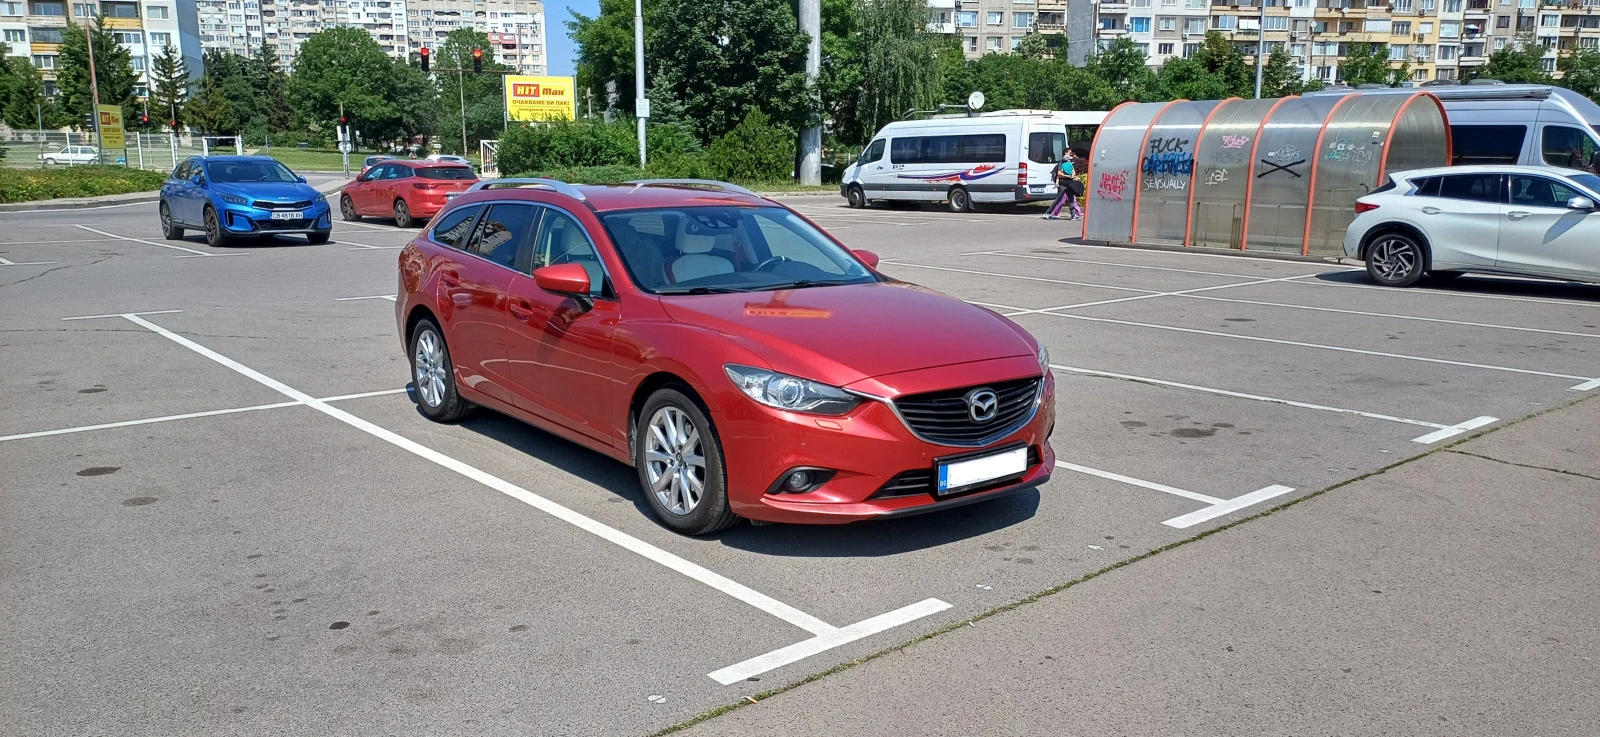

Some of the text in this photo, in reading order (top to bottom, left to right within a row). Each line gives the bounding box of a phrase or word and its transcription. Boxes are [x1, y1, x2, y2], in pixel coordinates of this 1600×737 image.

[516, 86, 537, 95] HIT
[1150, 137, 1189, 153] FUCK
[1143, 178, 1186, 190] SENSUALLY
